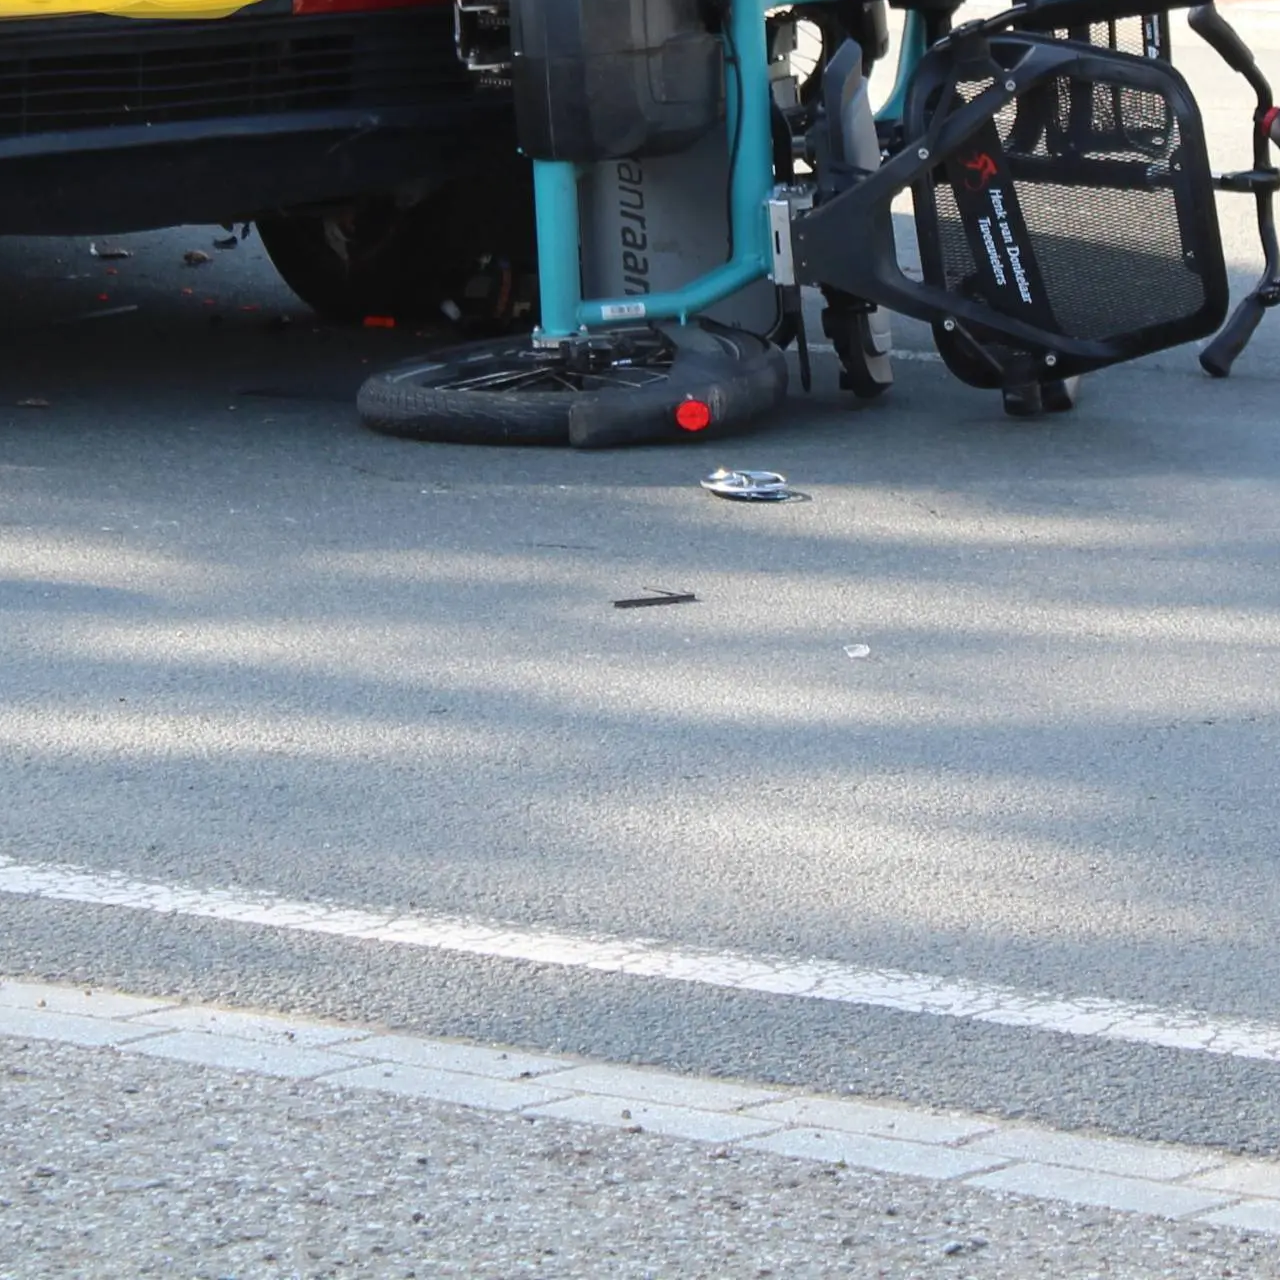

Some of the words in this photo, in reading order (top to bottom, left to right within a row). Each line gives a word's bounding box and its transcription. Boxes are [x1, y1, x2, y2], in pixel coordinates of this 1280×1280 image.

[978, 216, 1007, 286] Tweewielers
[989, 188, 1008, 220] Henk
[999, 221, 1013, 243] van
[1006, 246, 1032, 304] Donkelaar
